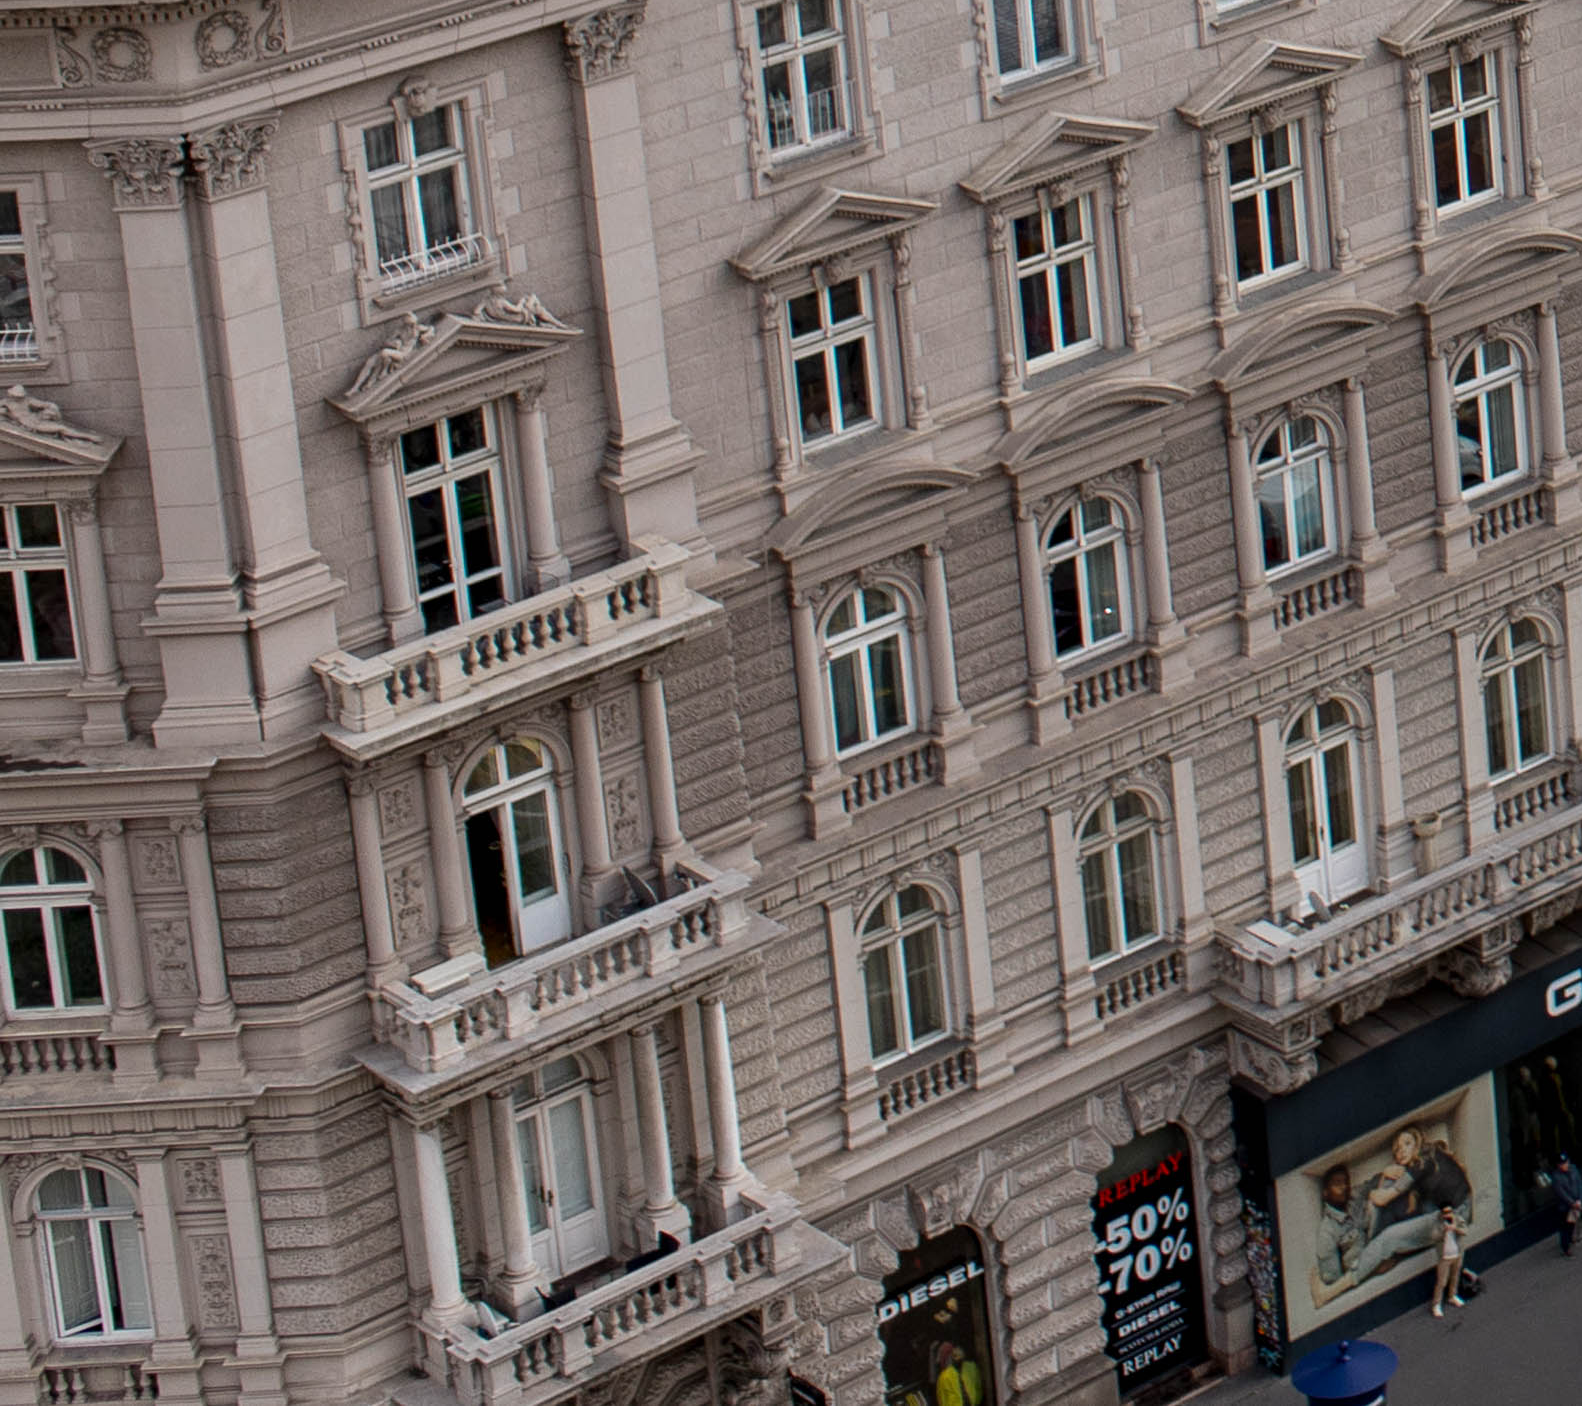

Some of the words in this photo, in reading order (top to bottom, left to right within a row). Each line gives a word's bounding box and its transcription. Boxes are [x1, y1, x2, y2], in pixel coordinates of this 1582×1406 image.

[1098, 1151, 1183, 1208] REPLAY
[1094, 1186, 1189, 1255] -50%
[1098, 1227, 1193, 1295] -70%
[879, 1261, 984, 1324] DIESEL
[1118, 1300, 1182, 1338] DIESEL
[1122, 1334, 1182, 1376] REPLAY
